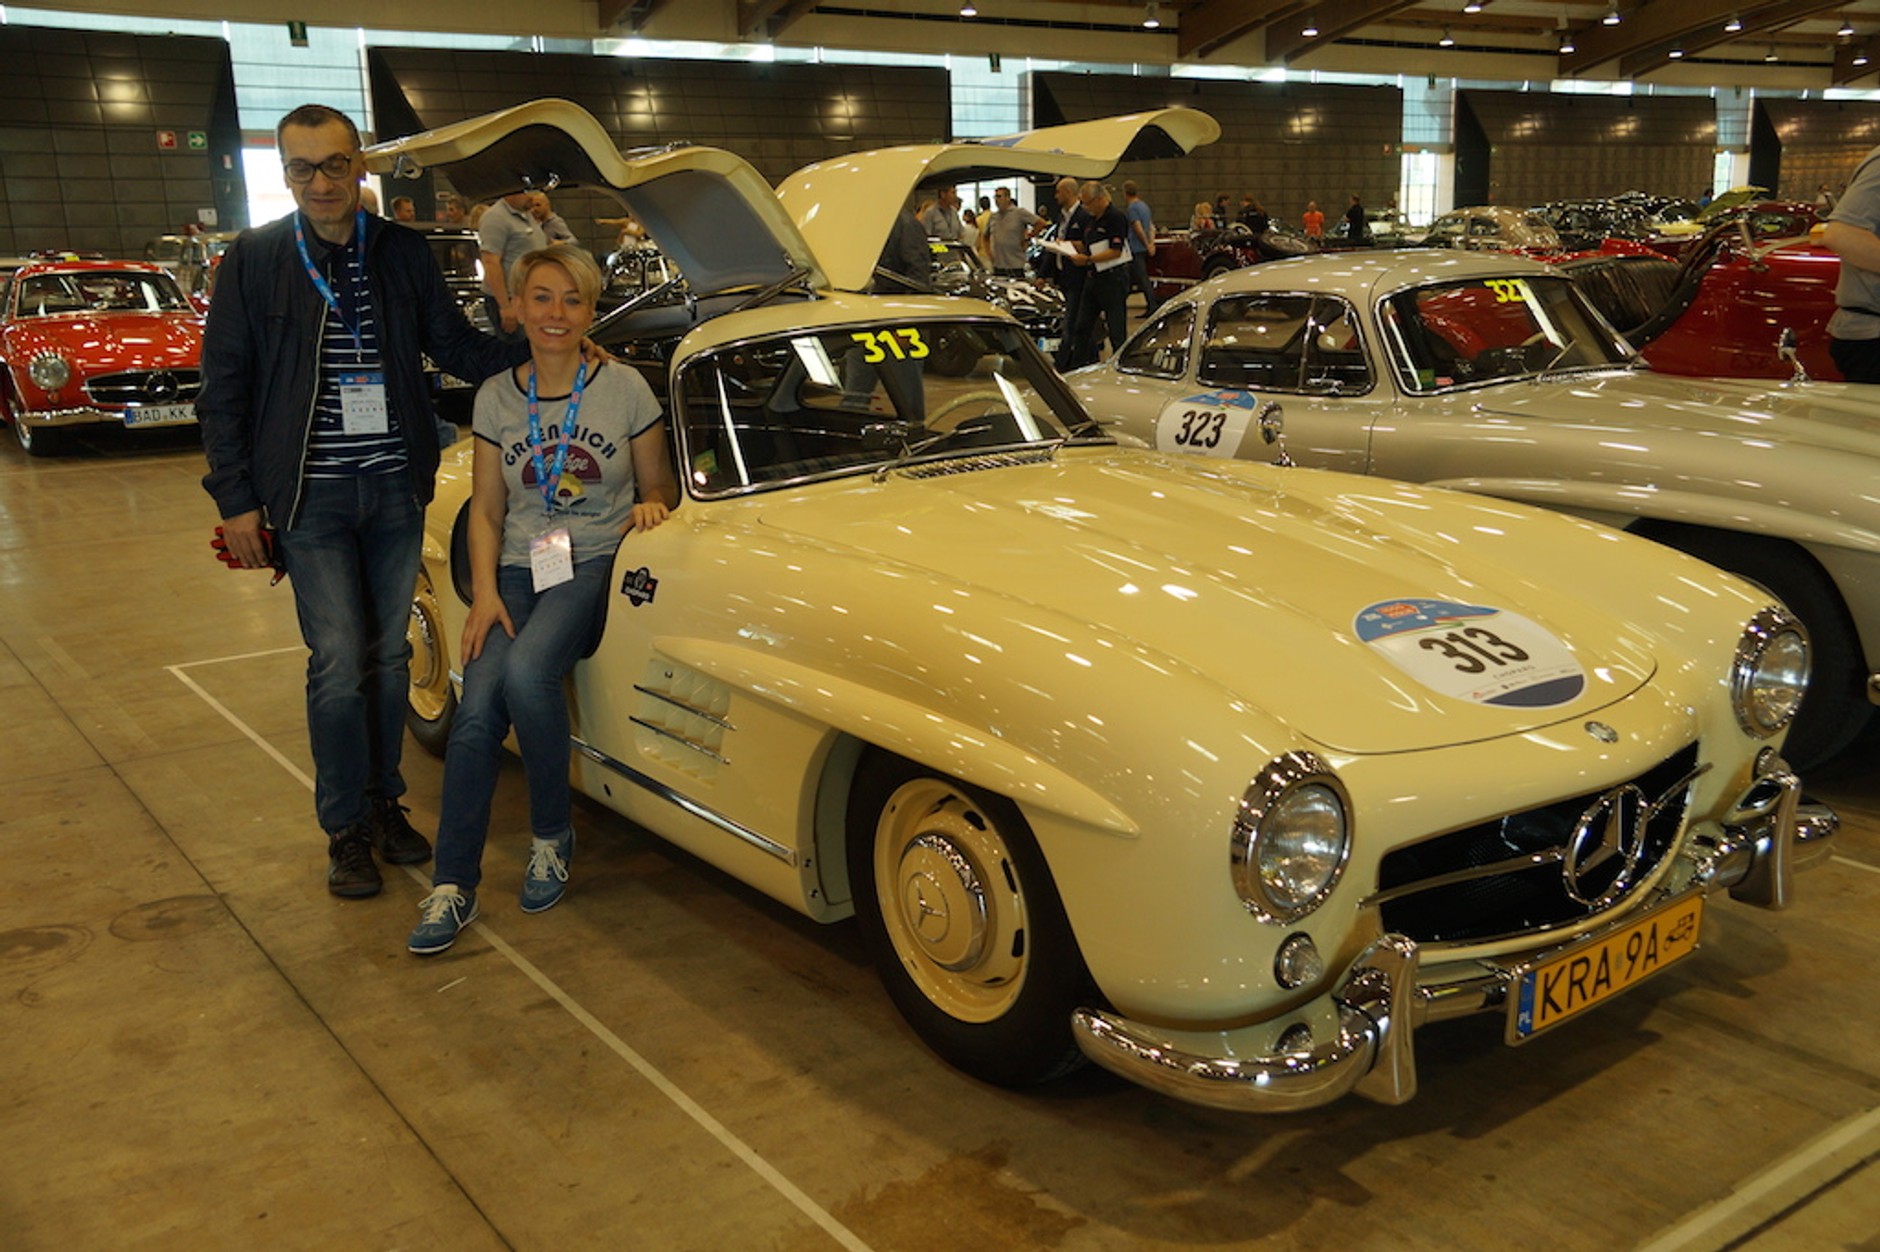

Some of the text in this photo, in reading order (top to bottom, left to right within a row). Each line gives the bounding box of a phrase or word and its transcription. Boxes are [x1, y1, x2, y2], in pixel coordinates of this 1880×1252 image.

[851, 328, 929, 362] 313
[133, 409, 160, 423] BAD
[169, 406, 187, 420] KK
[1175, 410, 1227, 448] 323
[1418, 627, 1529, 674] 313
[1541, 921, 1659, 1021] KRA 9A
[1519, 1010, 1531, 1027] PL
